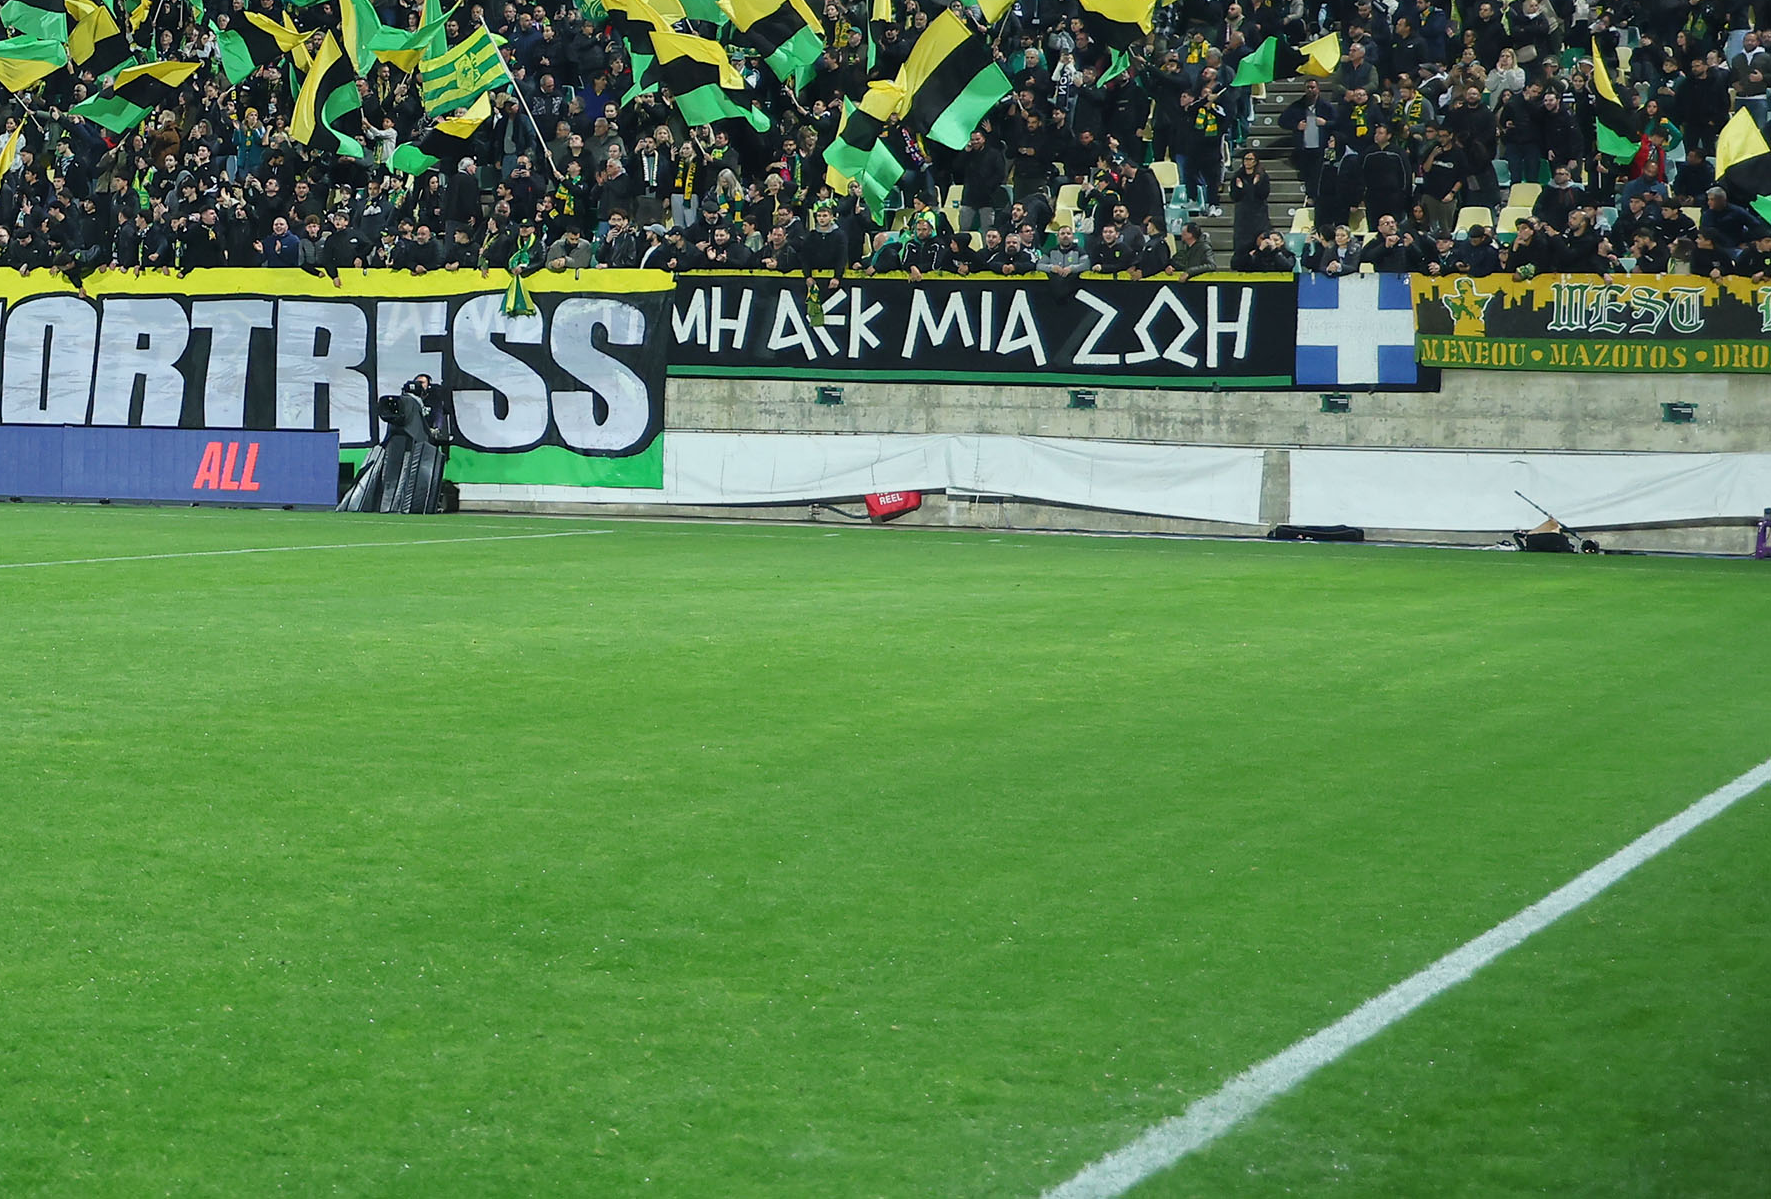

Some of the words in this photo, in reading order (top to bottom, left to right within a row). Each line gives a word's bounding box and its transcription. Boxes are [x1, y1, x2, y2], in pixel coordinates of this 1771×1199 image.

[1072, 284, 1253, 368] ΖΩΗ
[1547, 282, 1706, 335] WEST
[1421, 338, 1526, 367] MENEOU
[1548, 343, 1688, 369] MAZOTOS
[1712, 344, 1771, 369] DRO
[193, 441, 260, 491] ALL
[878, 493, 903, 506] REEL
